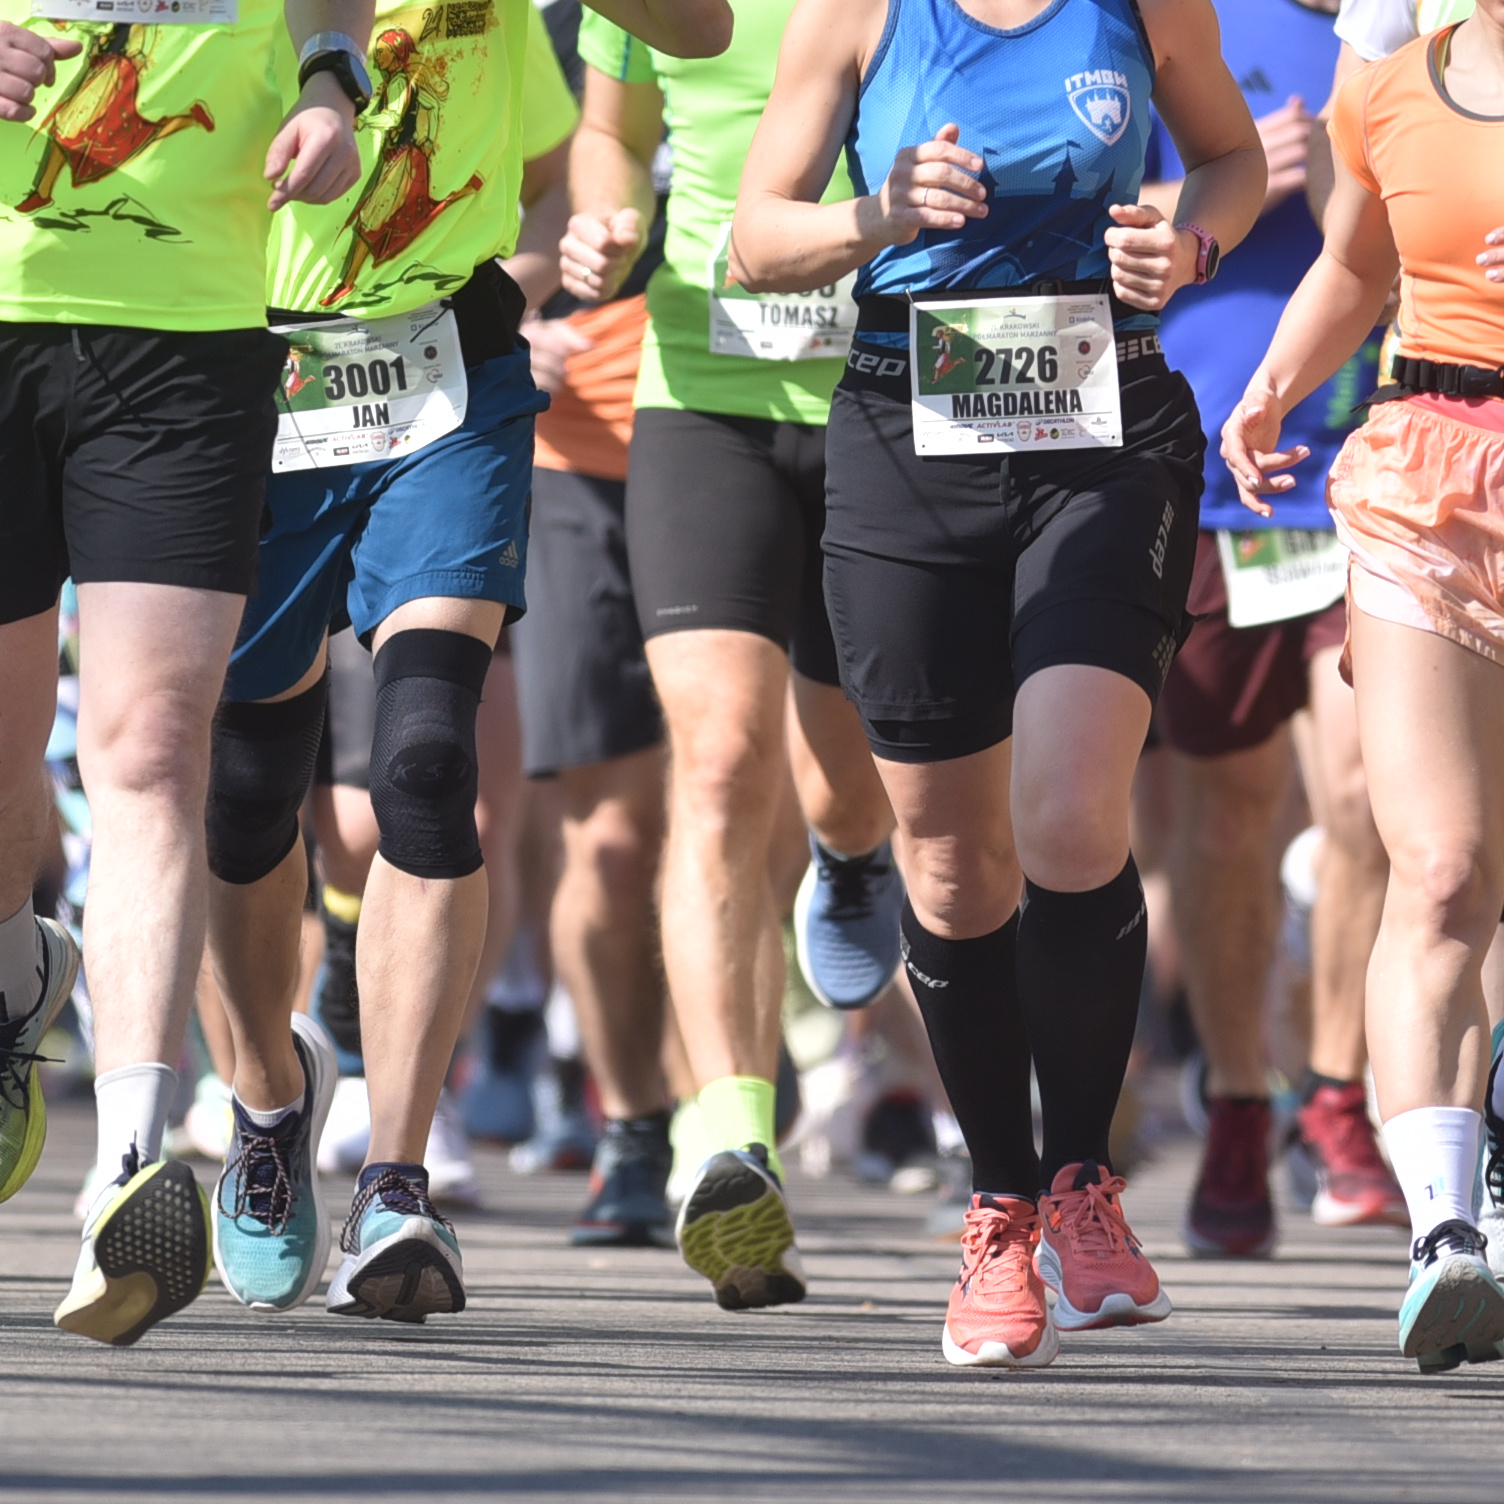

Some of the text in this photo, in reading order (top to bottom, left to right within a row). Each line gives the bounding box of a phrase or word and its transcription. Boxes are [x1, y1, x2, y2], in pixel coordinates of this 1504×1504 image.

[759, 303, 839, 328] TOMASZ
[1000, 322, 1039, 331] KRAKOWSKI
[322, 355, 408, 401] 3001
[974, 345, 1058, 386] 2726
[352, 402, 390, 429] JAN
[951, 389, 1083, 419] MAGDALENA
[907, 961, 949, 989] cep
